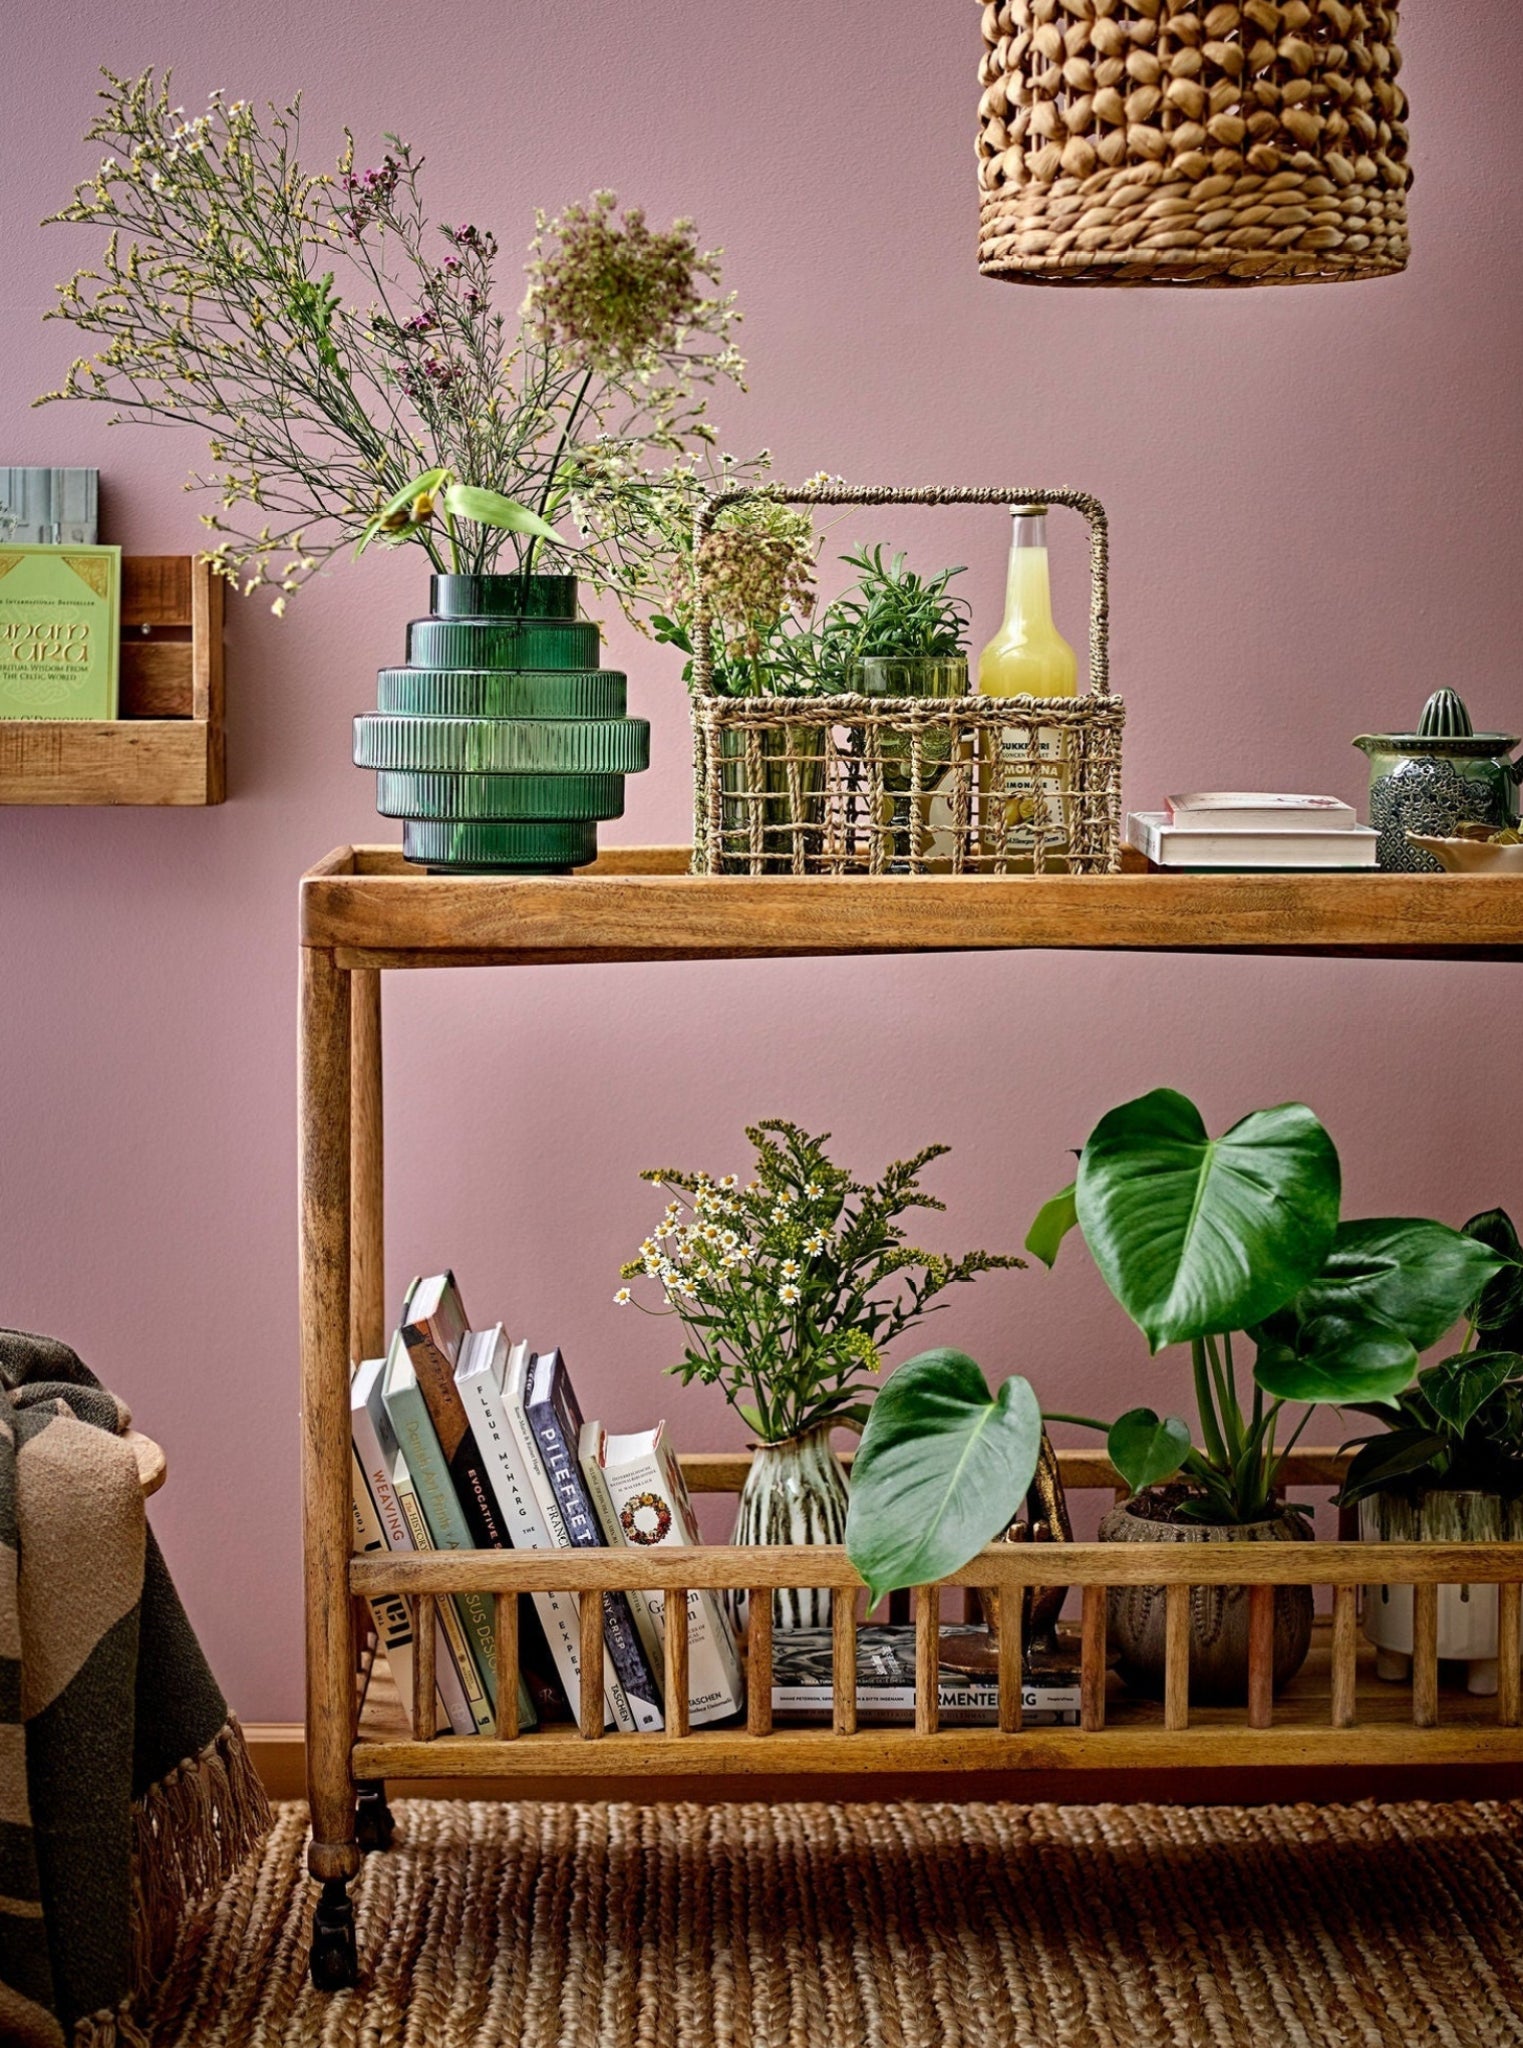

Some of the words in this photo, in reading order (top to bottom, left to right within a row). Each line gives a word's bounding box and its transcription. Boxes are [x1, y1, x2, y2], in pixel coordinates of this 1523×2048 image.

[3, 672, 17, 680] THE
[31, 664, 64, 673] WISDOM
[477, 1385, 501, 1441] FLEUR
[541, 1427, 592, 1541] PILEFLET
[373, 1470, 404, 1541] WEAVING
[468, 1468, 499, 1540] EVOCATIVE
[410, 1512, 428, 1551] HISTORY
[522, 1526, 535, 1534] THE
[547, 1504, 569, 1549] FRANCI
[374, 1609, 384, 1627] THE
[609, 1617, 626, 1650] CRISP
[477, 1625, 497, 1674] DESIG
[558, 1621, 581, 1682] EXPER
[611, 1683, 630, 1723] TASCHEN
[688, 1692, 722, 1706] TASCHEN
[914, 1693, 1037, 1706] RMENTEG
